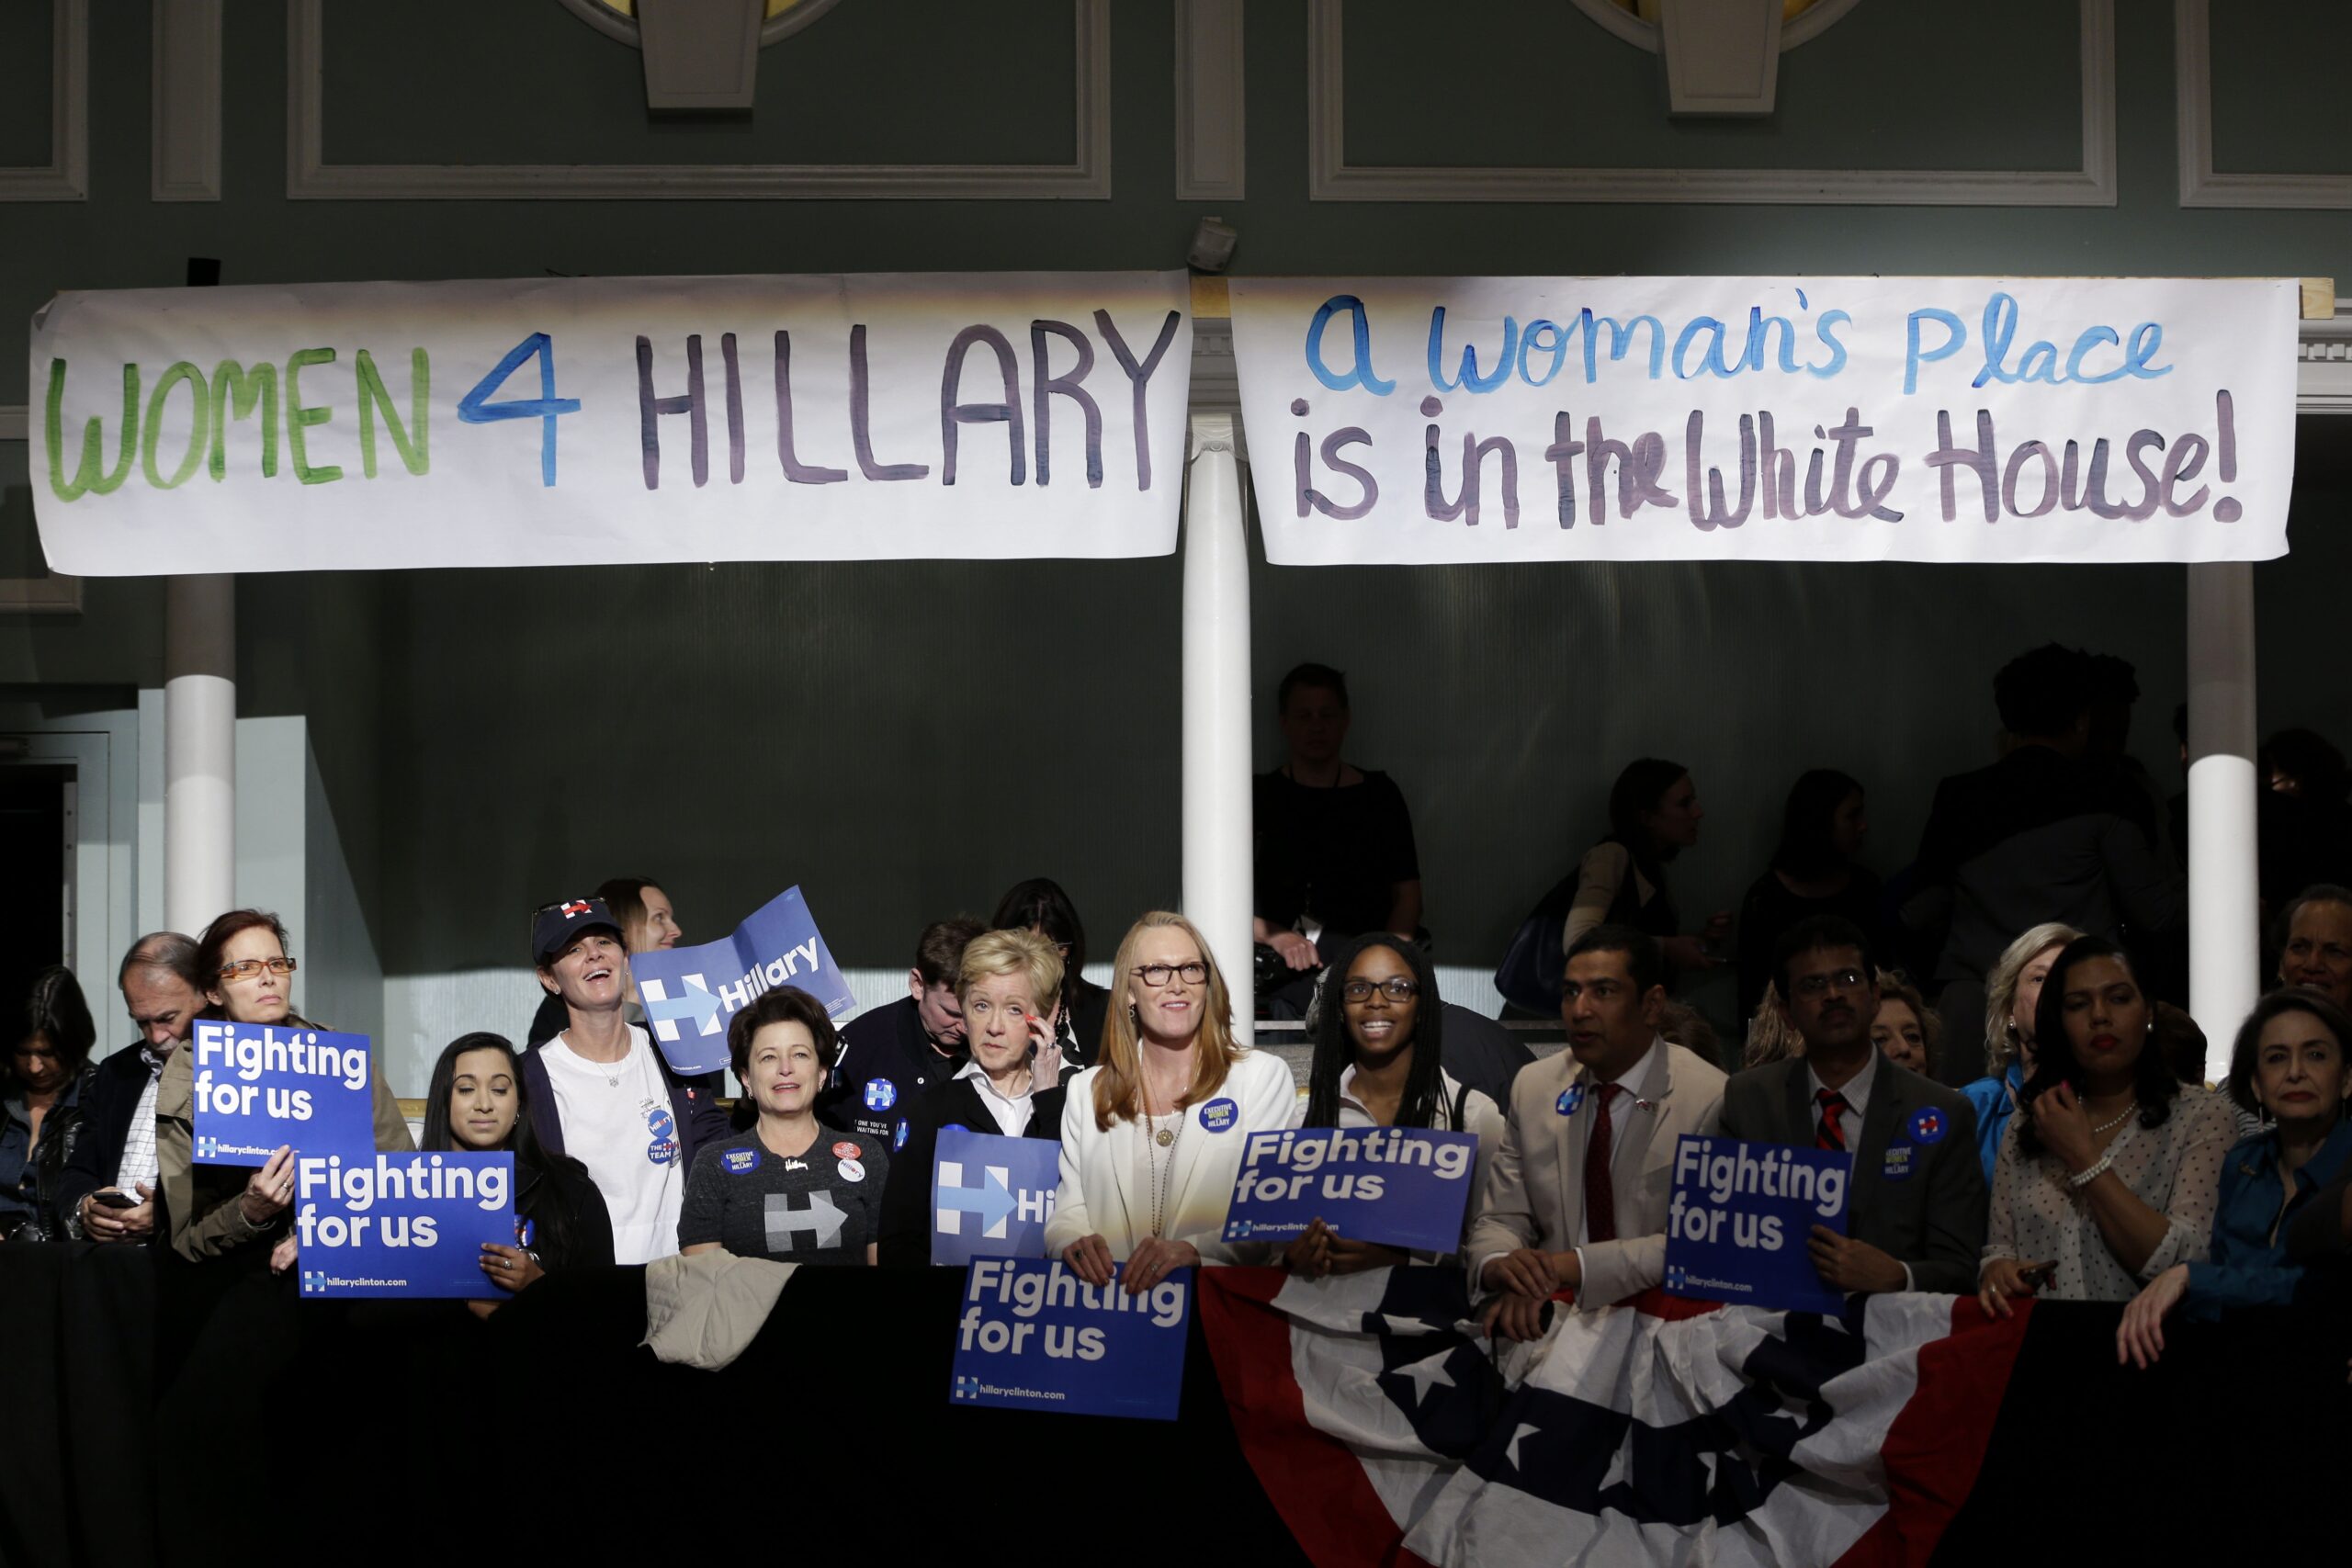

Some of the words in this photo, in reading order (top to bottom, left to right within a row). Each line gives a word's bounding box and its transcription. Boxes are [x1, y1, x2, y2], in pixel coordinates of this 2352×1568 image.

[46, 347, 431, 503] WOMEN
[458, 332, 582, 487] 4
[636, 308, 1182, 491] HILLARY
[1291, 396, 1378, 521] is
[1420, 396, 1520, 530] in
[1544, 411, 1679, 530] the
[1687, 407, 1905, 532] White
[1924, 389, 2243, 523] House!
[718, 936, 819, 1013] Hillary
[198, 1025, 368, 1091] Fighting
[195, 1070, 259, 1116] for
[267, 1088, 313, 1121] us
[218, 1144, 277, 1156] hillaryclinton.c
[650, 1151, 672, 1159] TEAM
[857, 1126, 879, 1134] WAITING
[1246, 1129, 1470, 1180] Fighting
[299, 1155, 508, 1211] Fighting
[1237, 1169, 1314, 1204] for
[1321, 1174, 1386, 1201] us
[1675, 1139, 1846, 1217] Fighting
[297, 1203, 370, 1247] for
[381, 1213, 438, 1247] us
[1669, 1190, 1726, 1244] for
[1735, 1214, 1784, 1251] us
[327, 1277, 407, 1288] hillaryclinton.com
[968, 1259, 1185, 1328] Fighting
[1685, 1273, 1753, 1292] hillaryclinton.com
[960, 1306, 1035, 1355] for
[1044, 1324, 1107, 1361] us
[979, 1384, 1066, 1400] hillaryclinton.com
